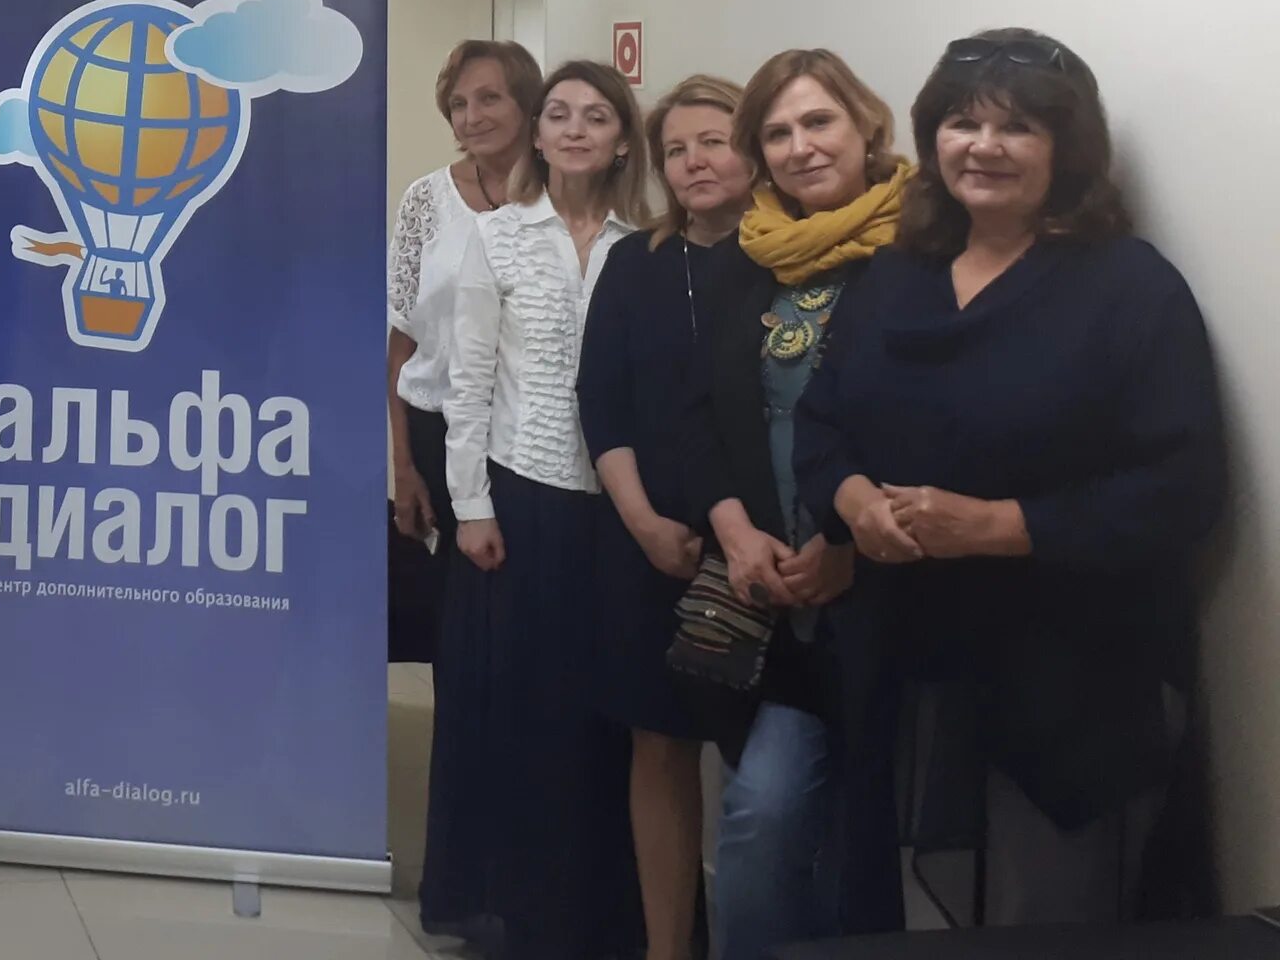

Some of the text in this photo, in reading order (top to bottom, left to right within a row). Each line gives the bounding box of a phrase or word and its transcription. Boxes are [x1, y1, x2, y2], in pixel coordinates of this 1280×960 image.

[36, 580, 180, 604] дополнительного
[185, 587, 290, 611] образования
[64, 778, 201, 807] alfa-dialog.ru
